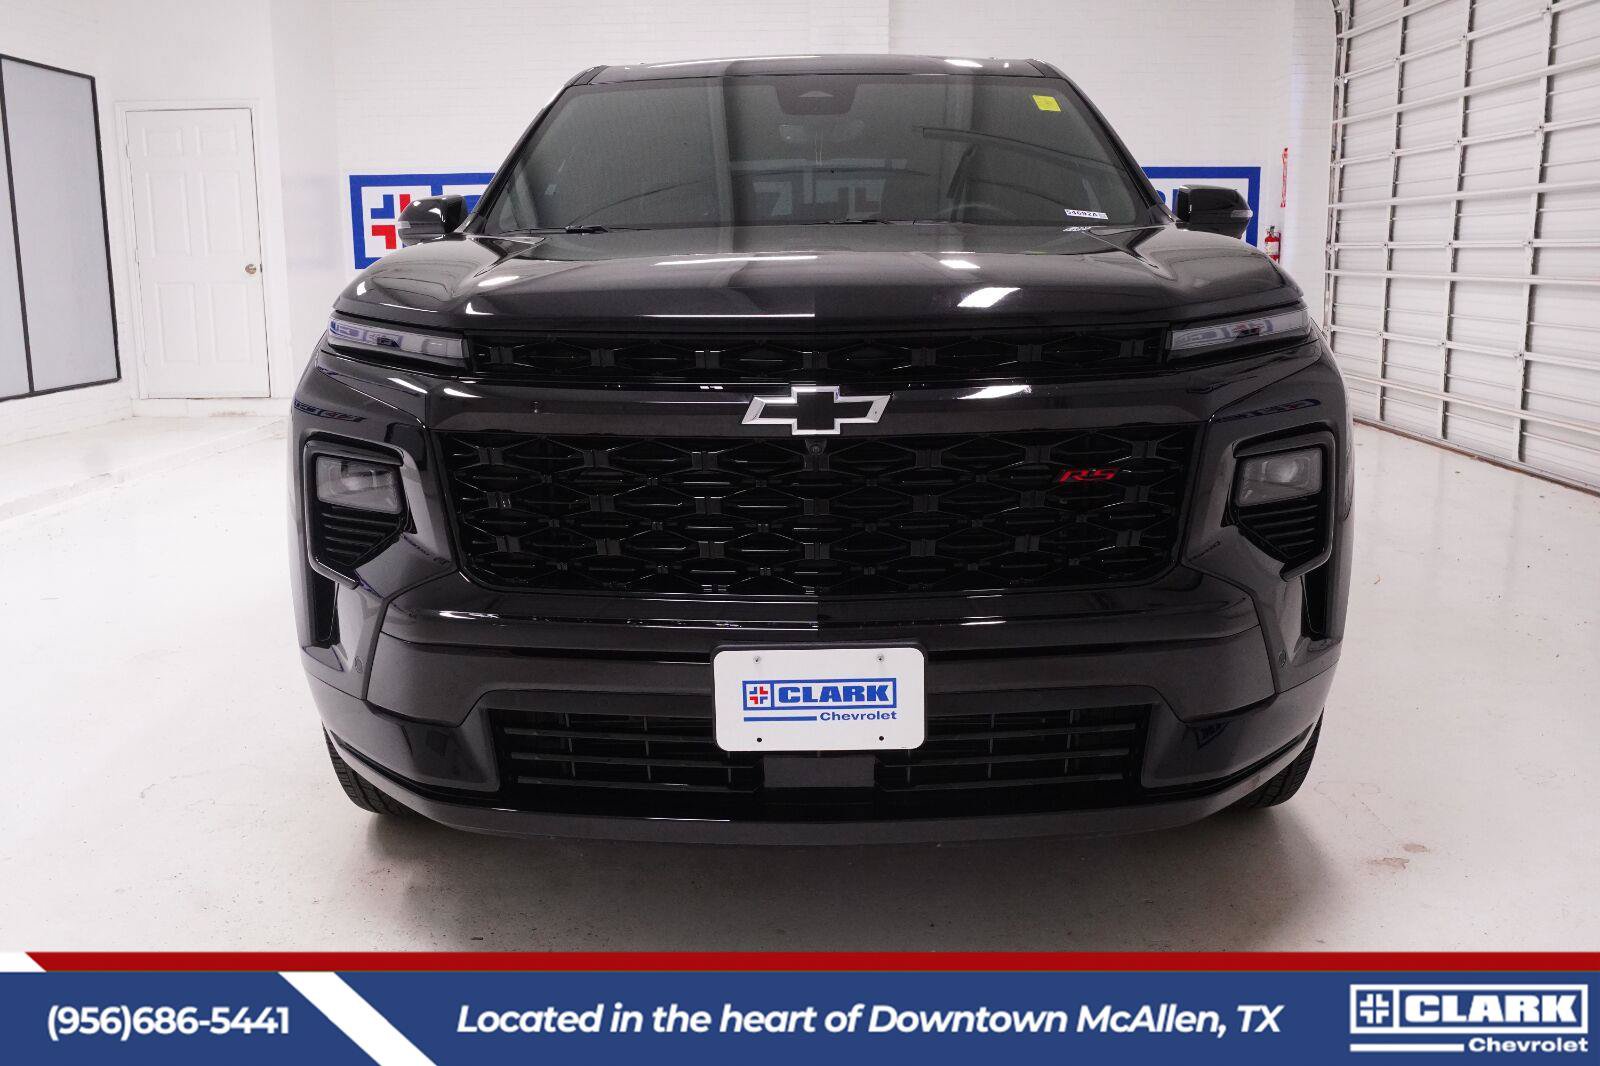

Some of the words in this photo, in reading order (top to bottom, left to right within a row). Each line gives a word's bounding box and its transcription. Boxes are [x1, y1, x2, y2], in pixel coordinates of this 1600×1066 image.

[1058, 467, 1119, 484] RS
[778, 684, 889, 703] CLARK
[819, 711, 897, 721] Chevrolet
